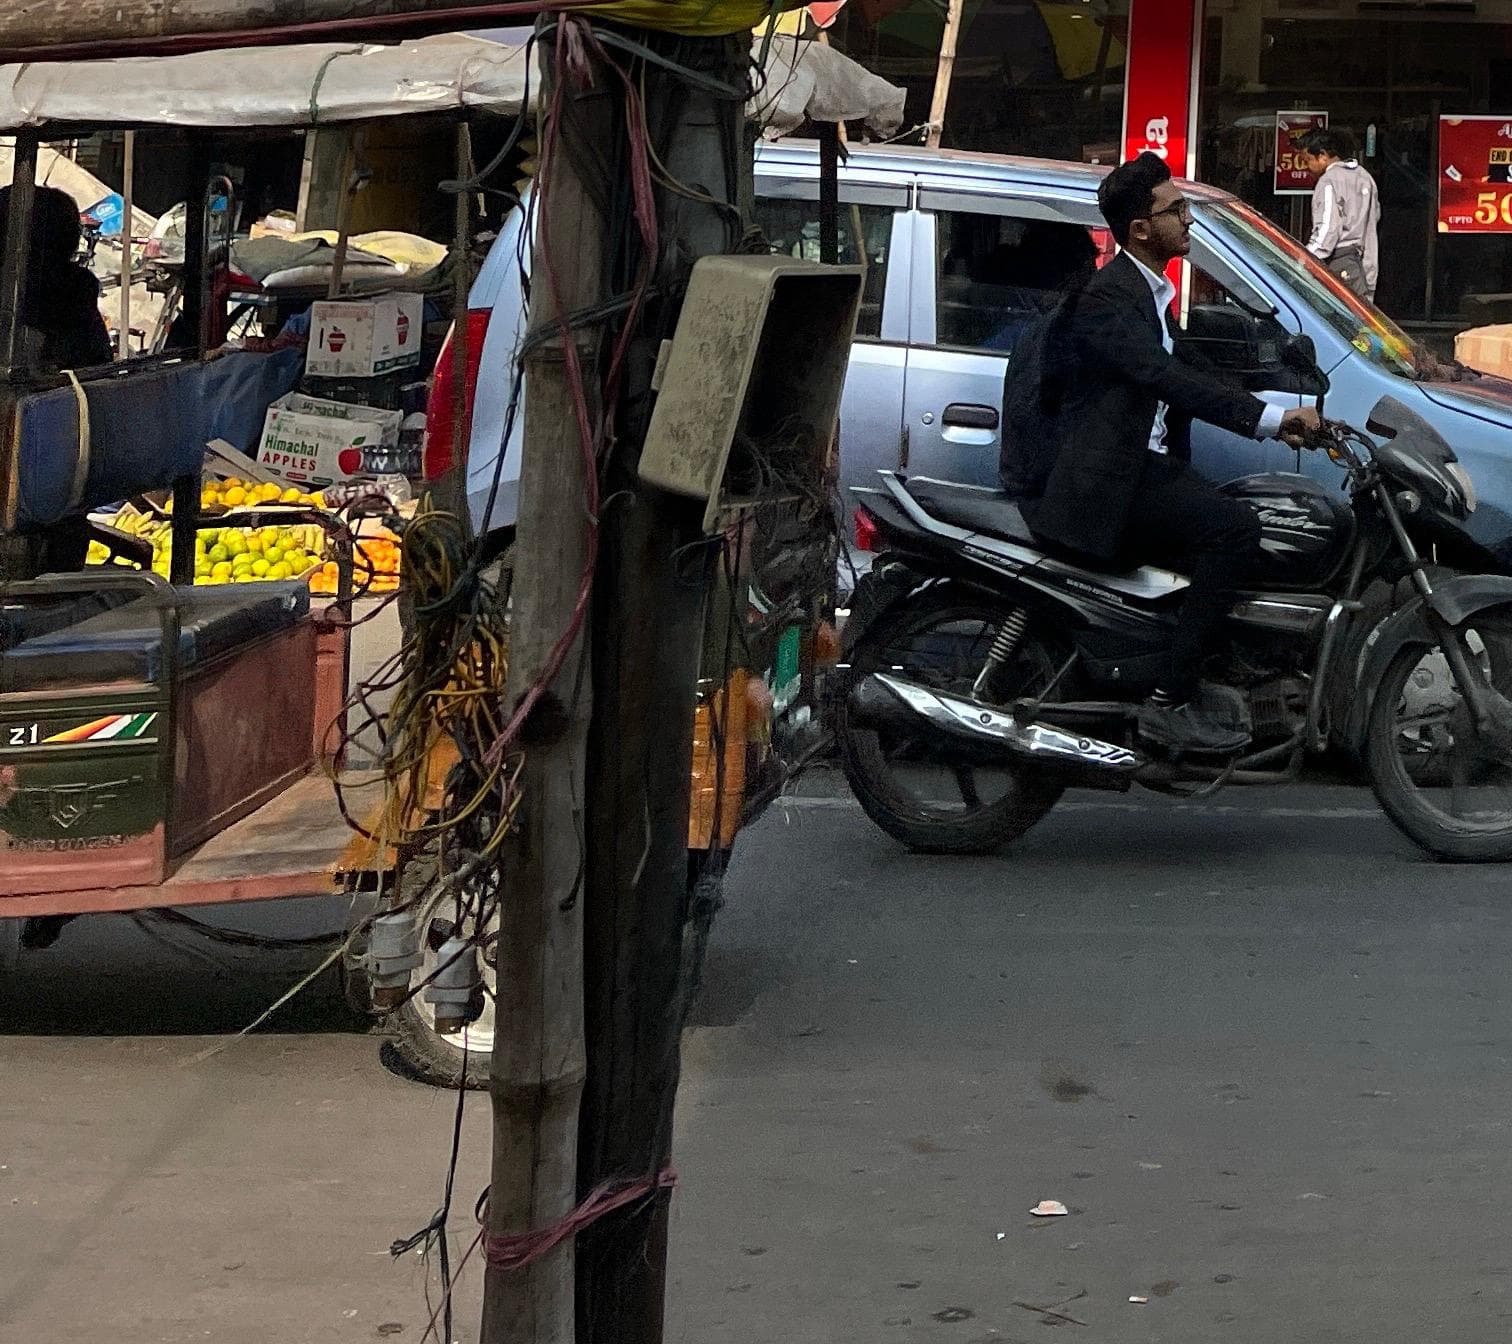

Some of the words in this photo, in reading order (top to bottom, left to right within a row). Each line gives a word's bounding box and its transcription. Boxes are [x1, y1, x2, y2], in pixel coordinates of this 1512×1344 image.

[1491, 149, 1507, 162] END
[1449, 215, 1473, 224] UPTO
[264, 435, 319, 457] Himachal
[262, 451, 317, 472] APPLES
